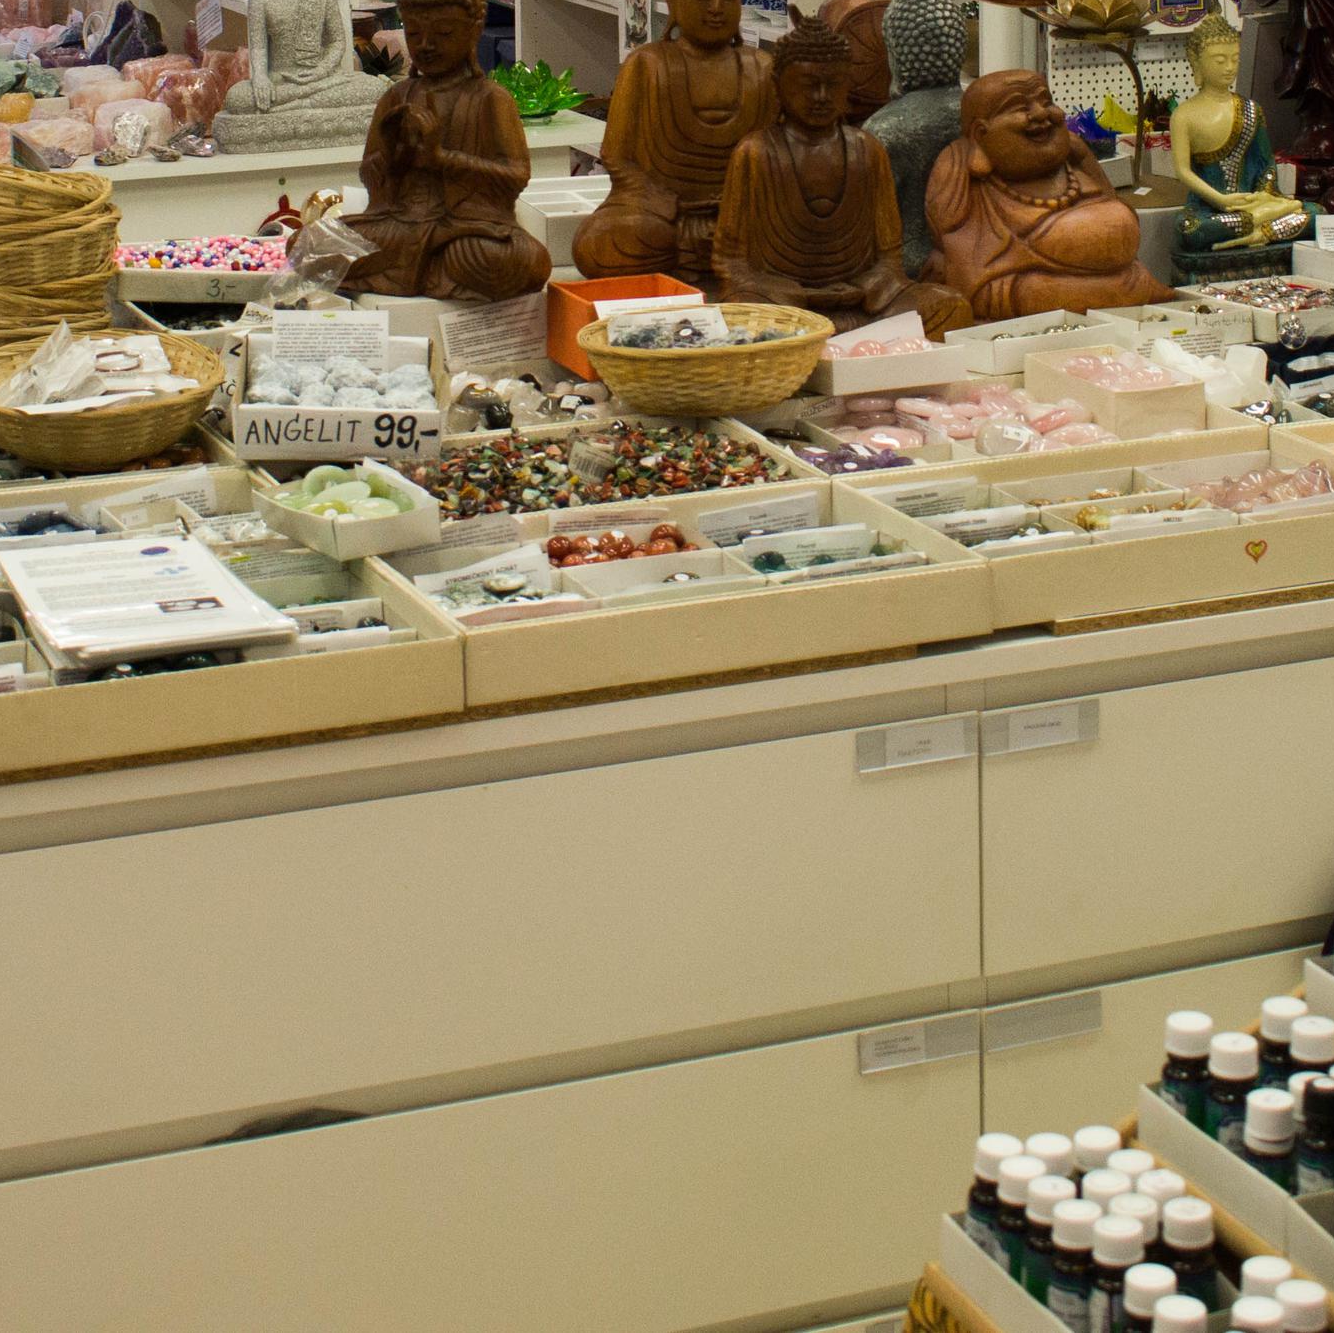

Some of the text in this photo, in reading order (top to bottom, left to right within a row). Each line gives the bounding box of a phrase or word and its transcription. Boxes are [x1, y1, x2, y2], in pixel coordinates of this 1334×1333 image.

[207, 278, 236, 301] 3,-
[244, 413, 439, 452] ANGELIT 99,-
